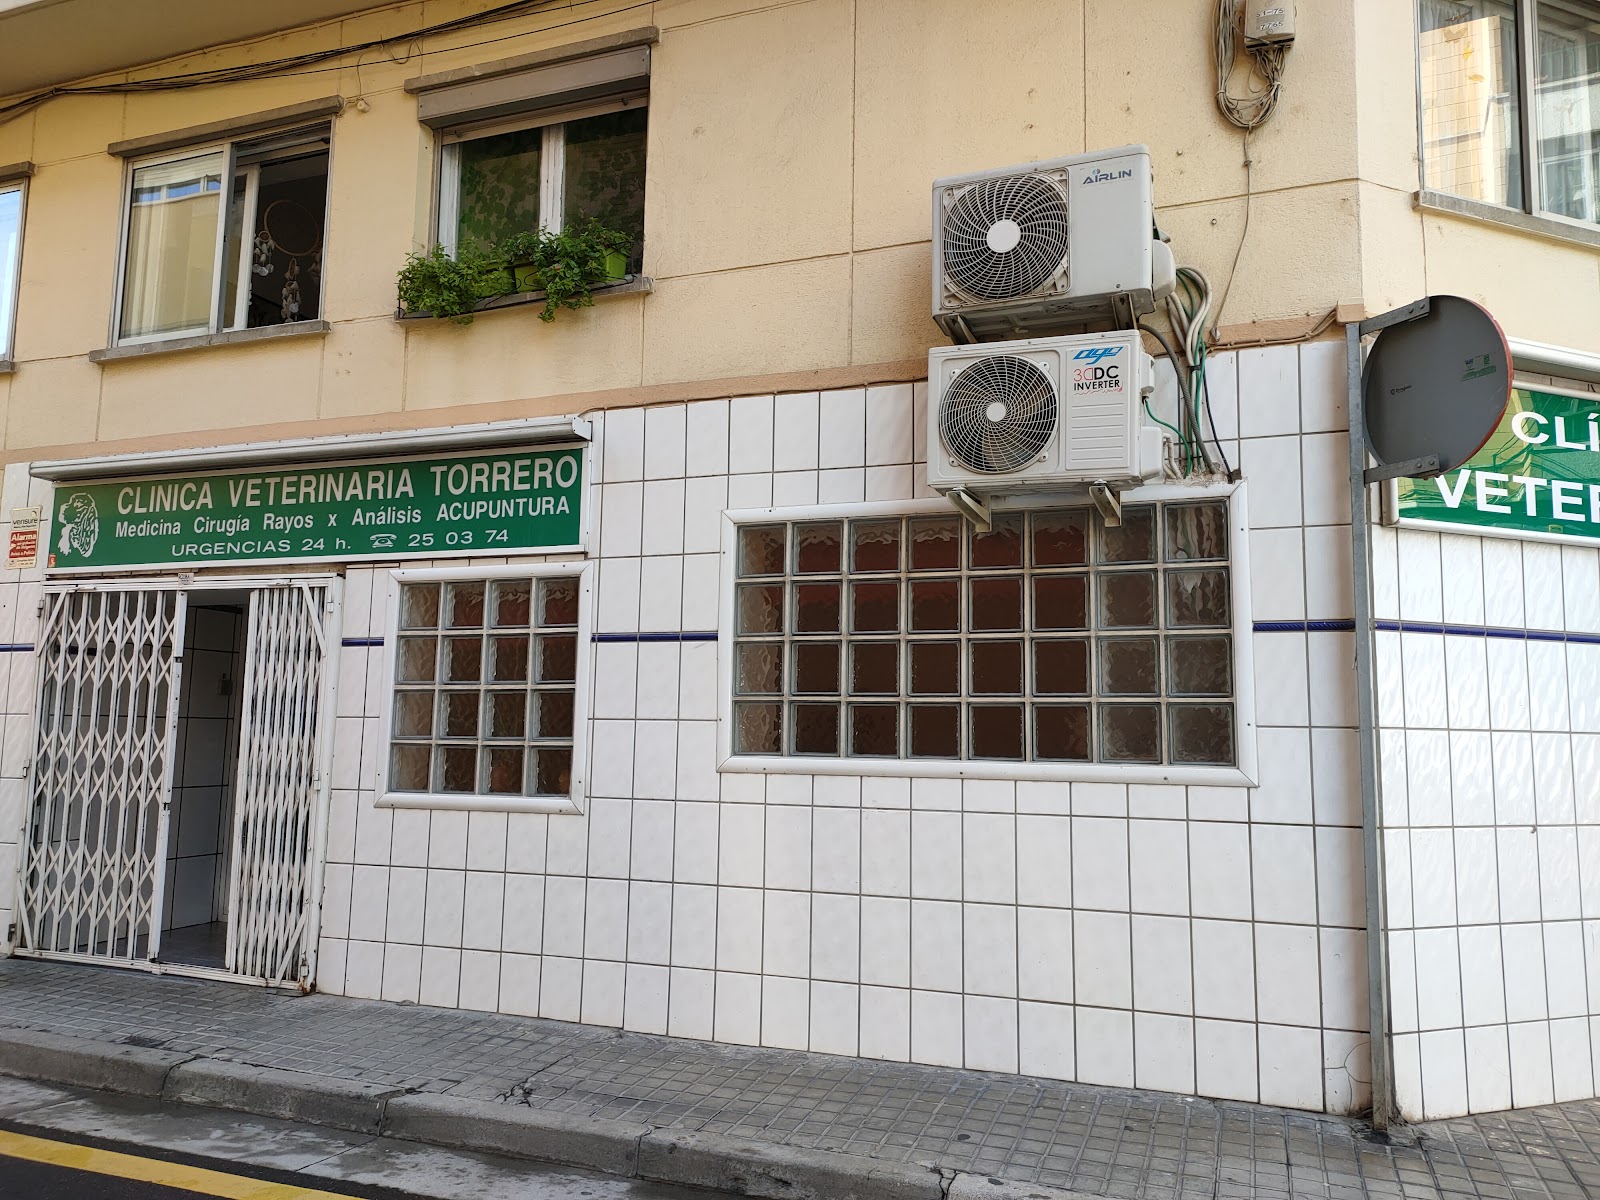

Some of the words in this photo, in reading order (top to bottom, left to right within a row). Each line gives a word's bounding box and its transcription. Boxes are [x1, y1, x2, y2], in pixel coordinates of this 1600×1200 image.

[1083, 169, 1132, 185] AIRLIN
[1074, 380, 1120, 391] INVERTER
[117, 481, 213, 515] CLINICA
[229, 468, 414, 508] VETERINARIA
[430, 455, 578, 496] TORRERO
[115, 519, 181, 538] Medicina
[193, 514, 250, 537] Cirugía
[263, 512, 314, 534] Rayos
[351, 505, 422, 526] Análisis
[436, 496, 570, 522] ACUPUNTURA
[11, 533, 37, 541] Alarma
[172, 539, 291, 556] URGENCIAS
[301, 538, 325, 551] 24
[335, 538, 351, 550] h.
[407, 533, 434, 547] 25
[445, 531, 473, 545] 03
[485, 529, 509, 543] 74
